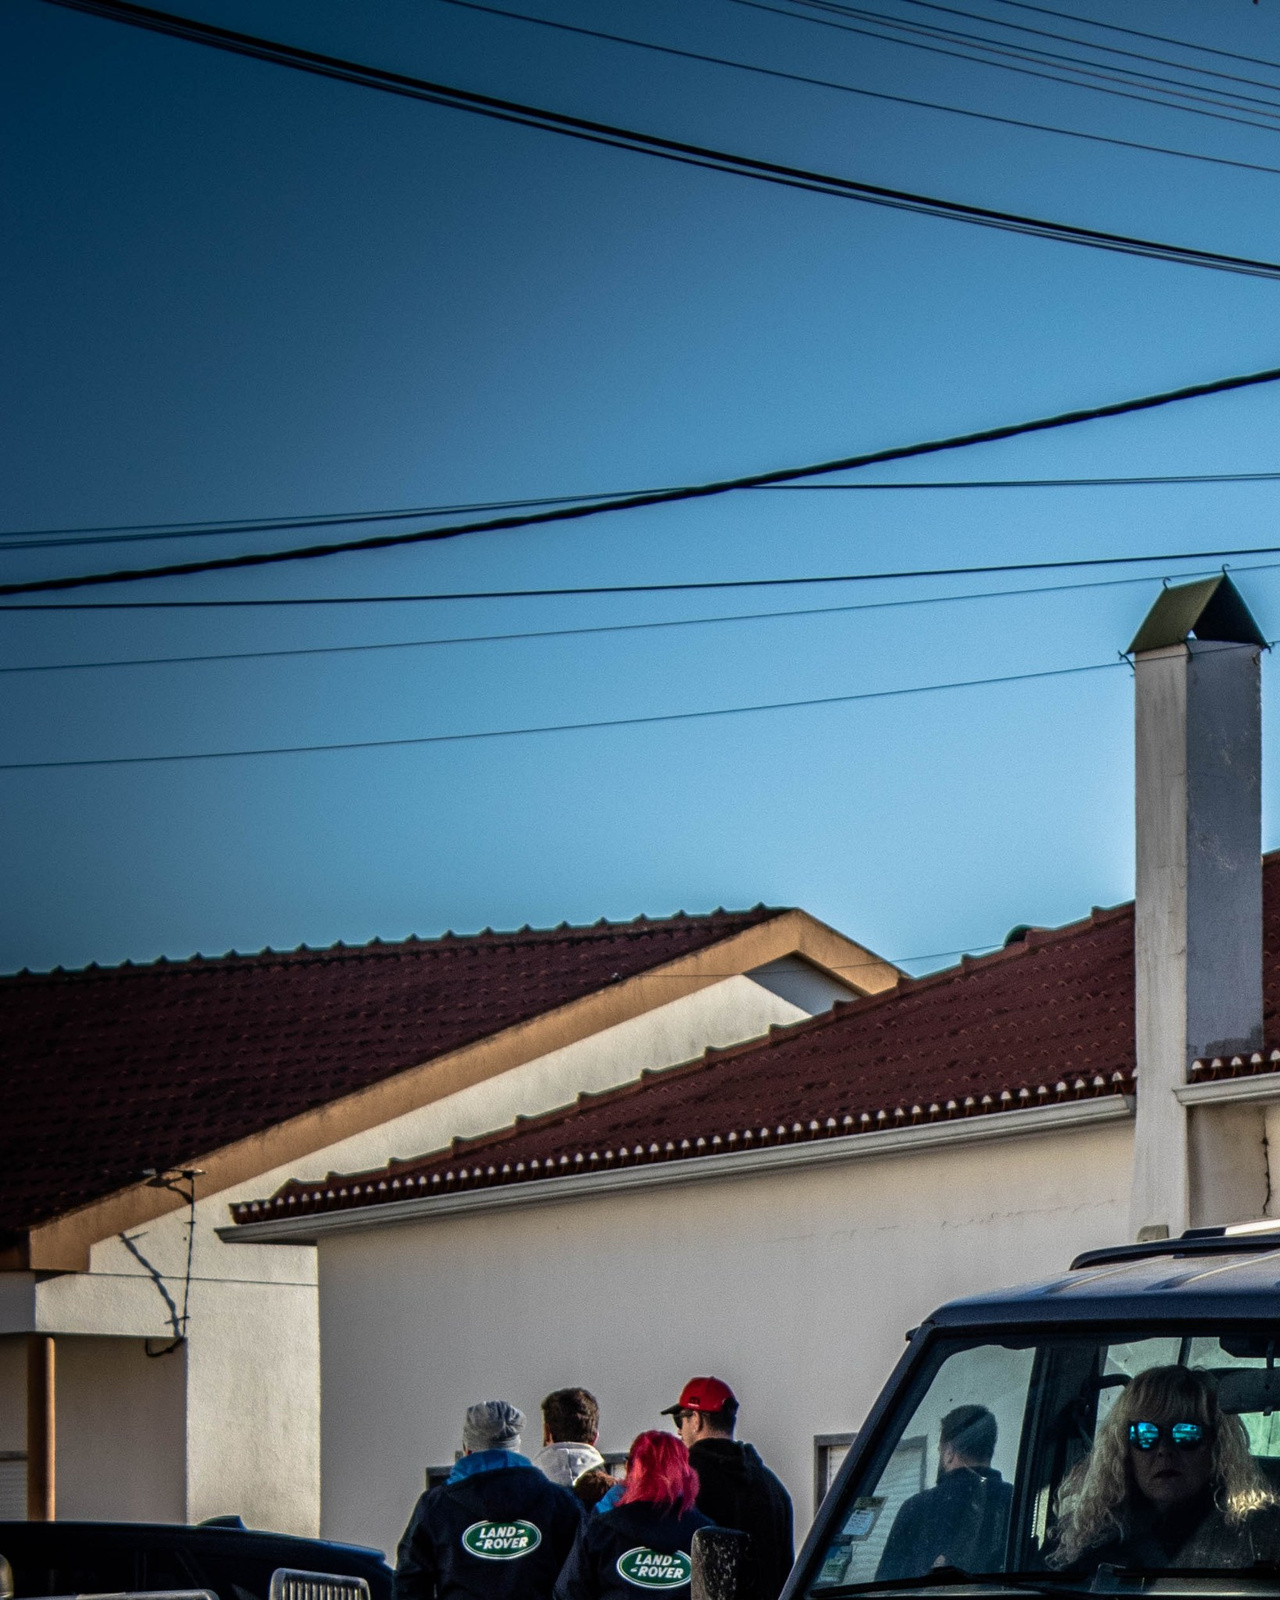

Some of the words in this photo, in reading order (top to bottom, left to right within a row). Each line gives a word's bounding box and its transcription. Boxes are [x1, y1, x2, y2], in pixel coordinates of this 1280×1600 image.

[479, 1526, 516, 1538] LAND
[482, 1536, 529, 1549] ROVER
[635, 1553, 673, 1566] LAND
[637, 1565, 684, 1579] ROVER
